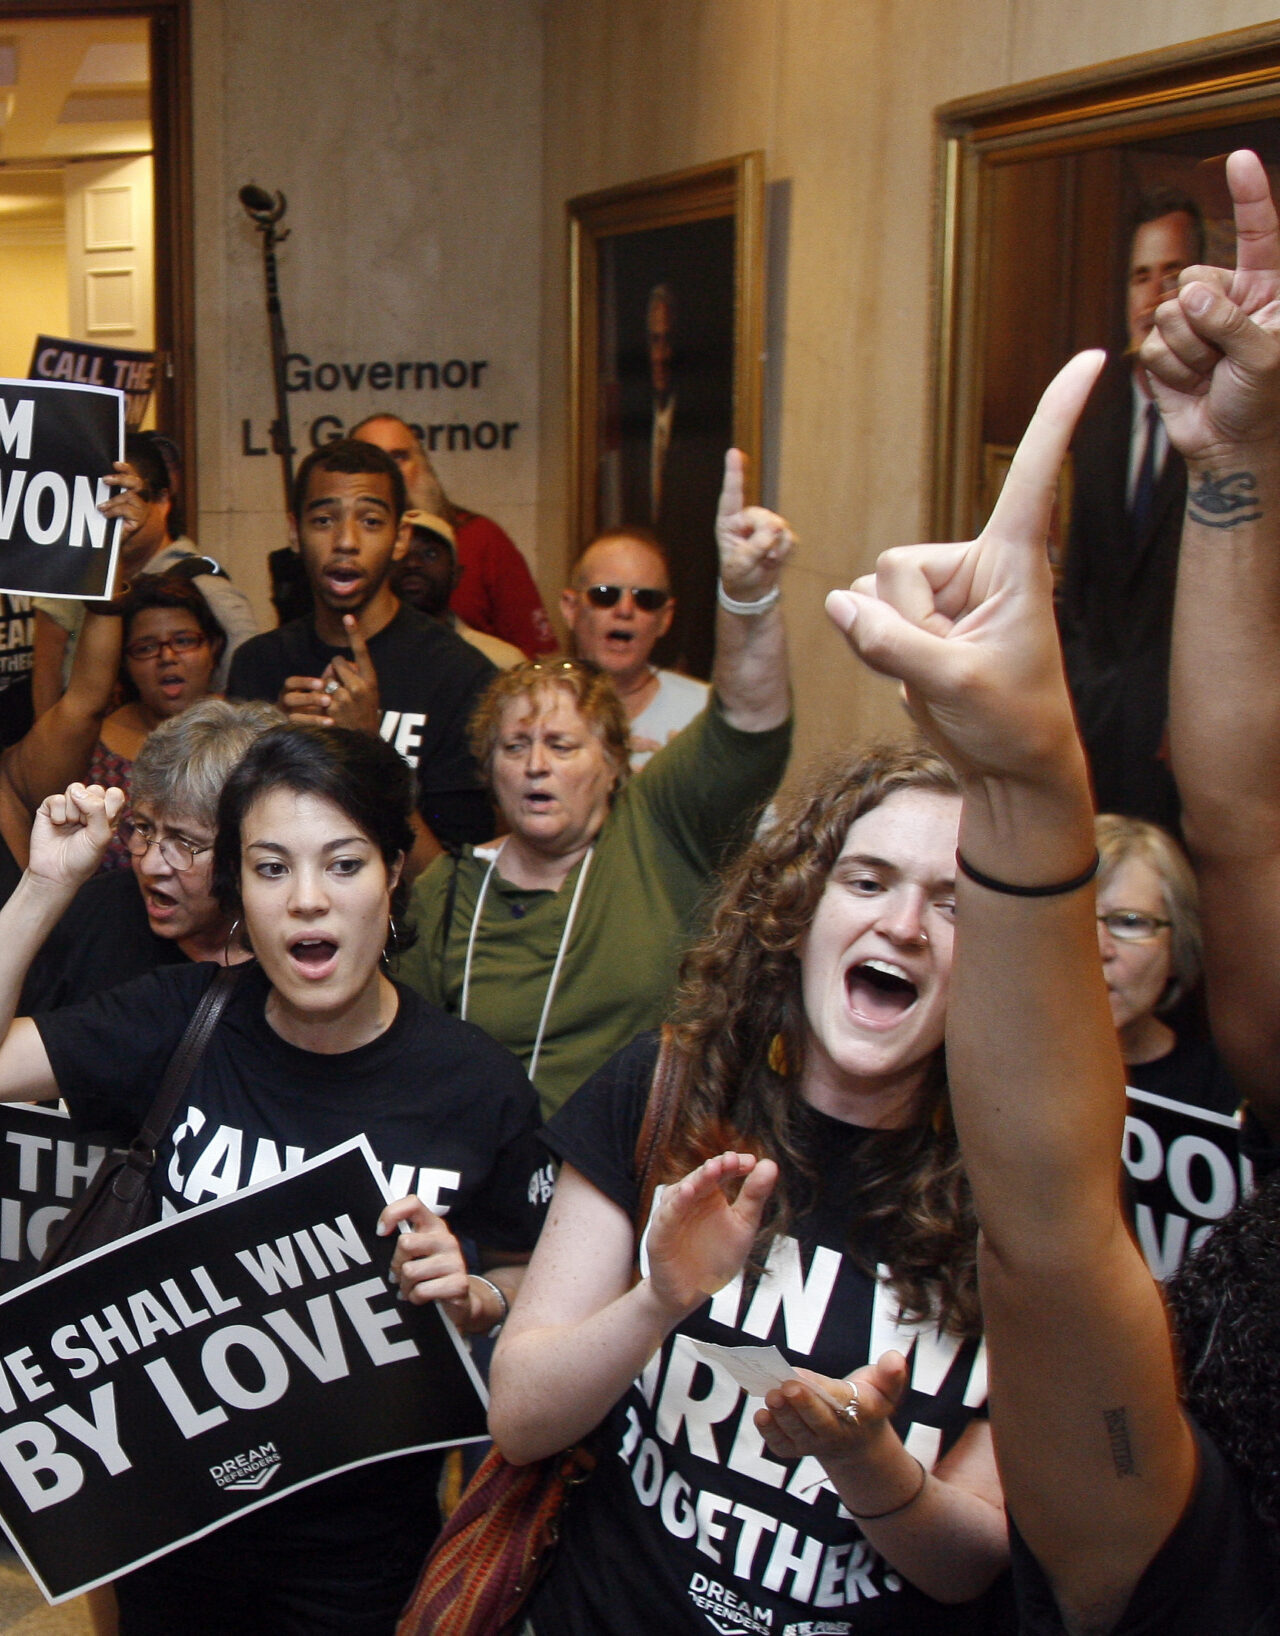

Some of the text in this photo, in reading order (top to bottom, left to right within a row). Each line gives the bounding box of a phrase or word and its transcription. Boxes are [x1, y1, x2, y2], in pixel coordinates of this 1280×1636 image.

[37, 348, 154, 389] CALL THE
[282, 353, 488, 392] Governor
[310, 415, 519, 450] Gernor
[7, 593, 32, 614] W
[6, 1130, 125, 1199] TH
[50, 1266, 242, 1379] SHALL
[235, 1213, 372, 1296] WIN
[143, 1277, 420, 1440] LOVE
[209, 1441, 277, 1481] DREAM
[215, 1452, 281, 1486] DEFENDERS
[687, 1590, 771, 1636] DEFENDERS
[689, 1572, 773, 1627] DREAM
